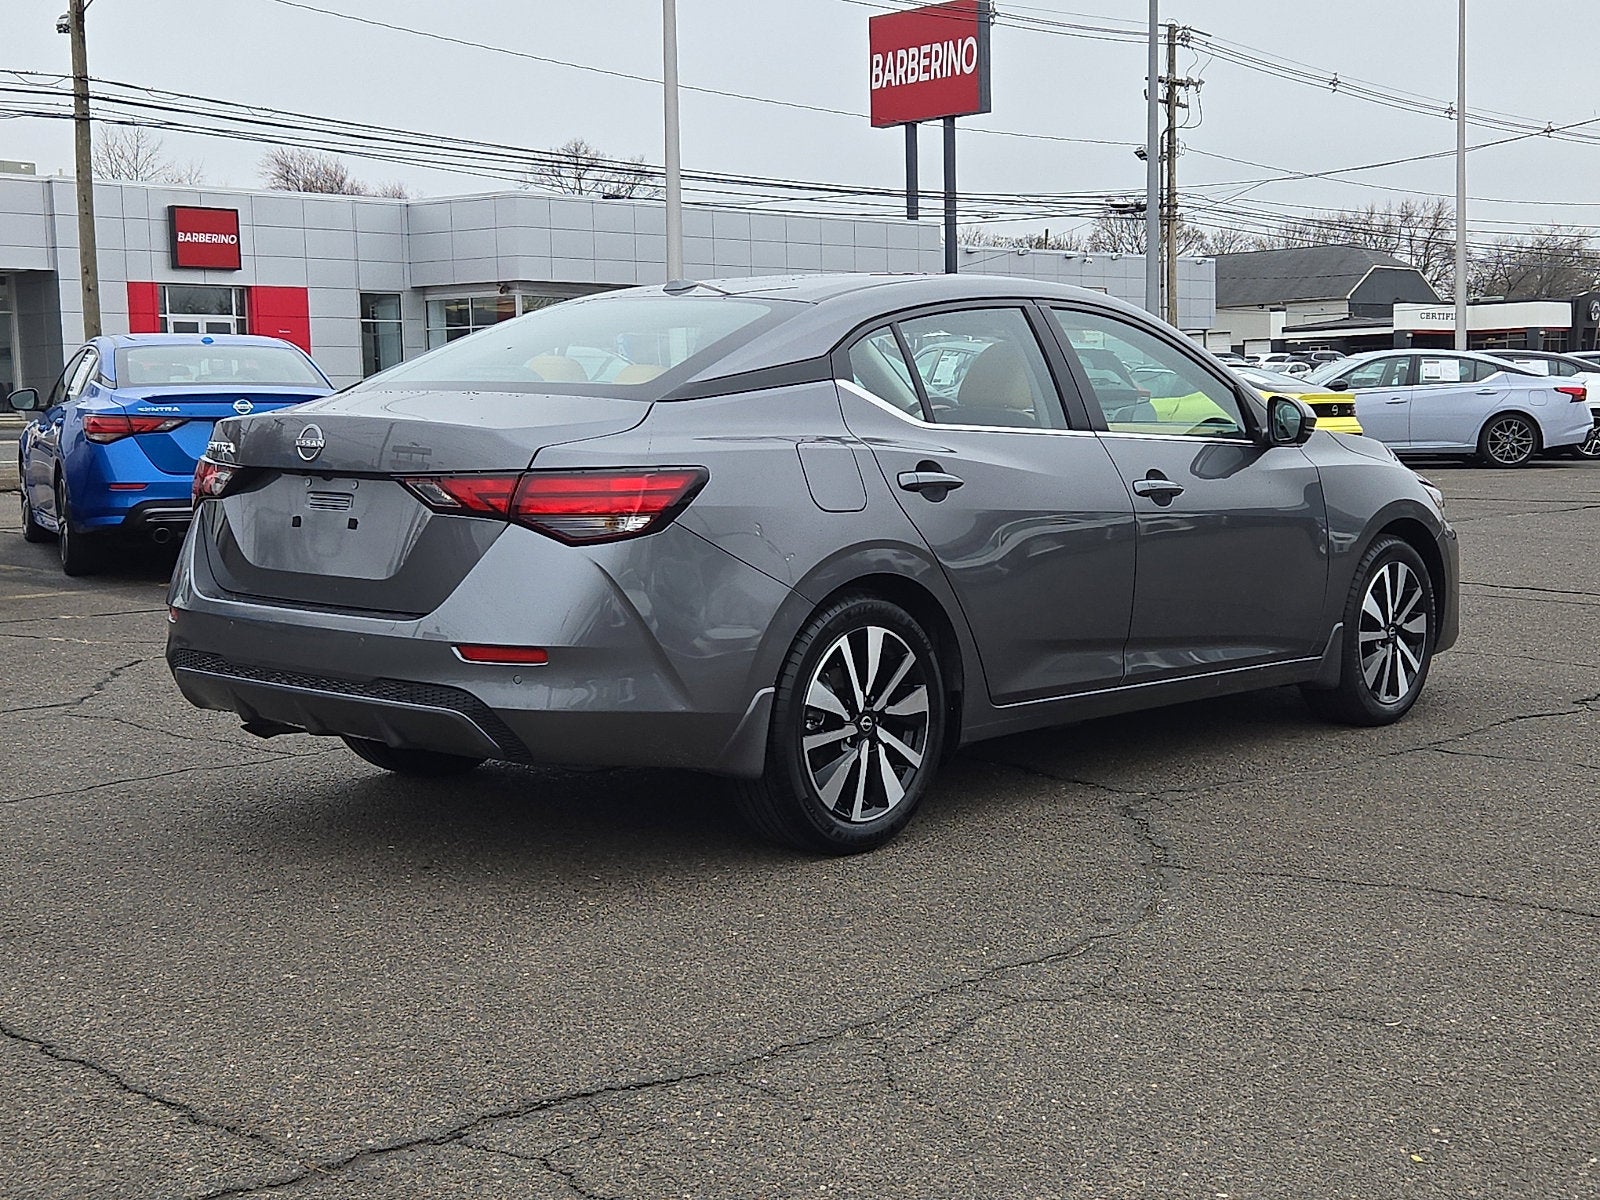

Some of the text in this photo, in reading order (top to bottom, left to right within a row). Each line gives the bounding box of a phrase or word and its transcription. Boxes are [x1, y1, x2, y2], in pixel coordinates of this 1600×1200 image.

[872, 36, 978, 90] BARBERINO
[178, 231, 237, 245] BARBERINO
[1420, 312, 1456, 321] CERTIFI
[296, 439, 325, 448] NISSAN
